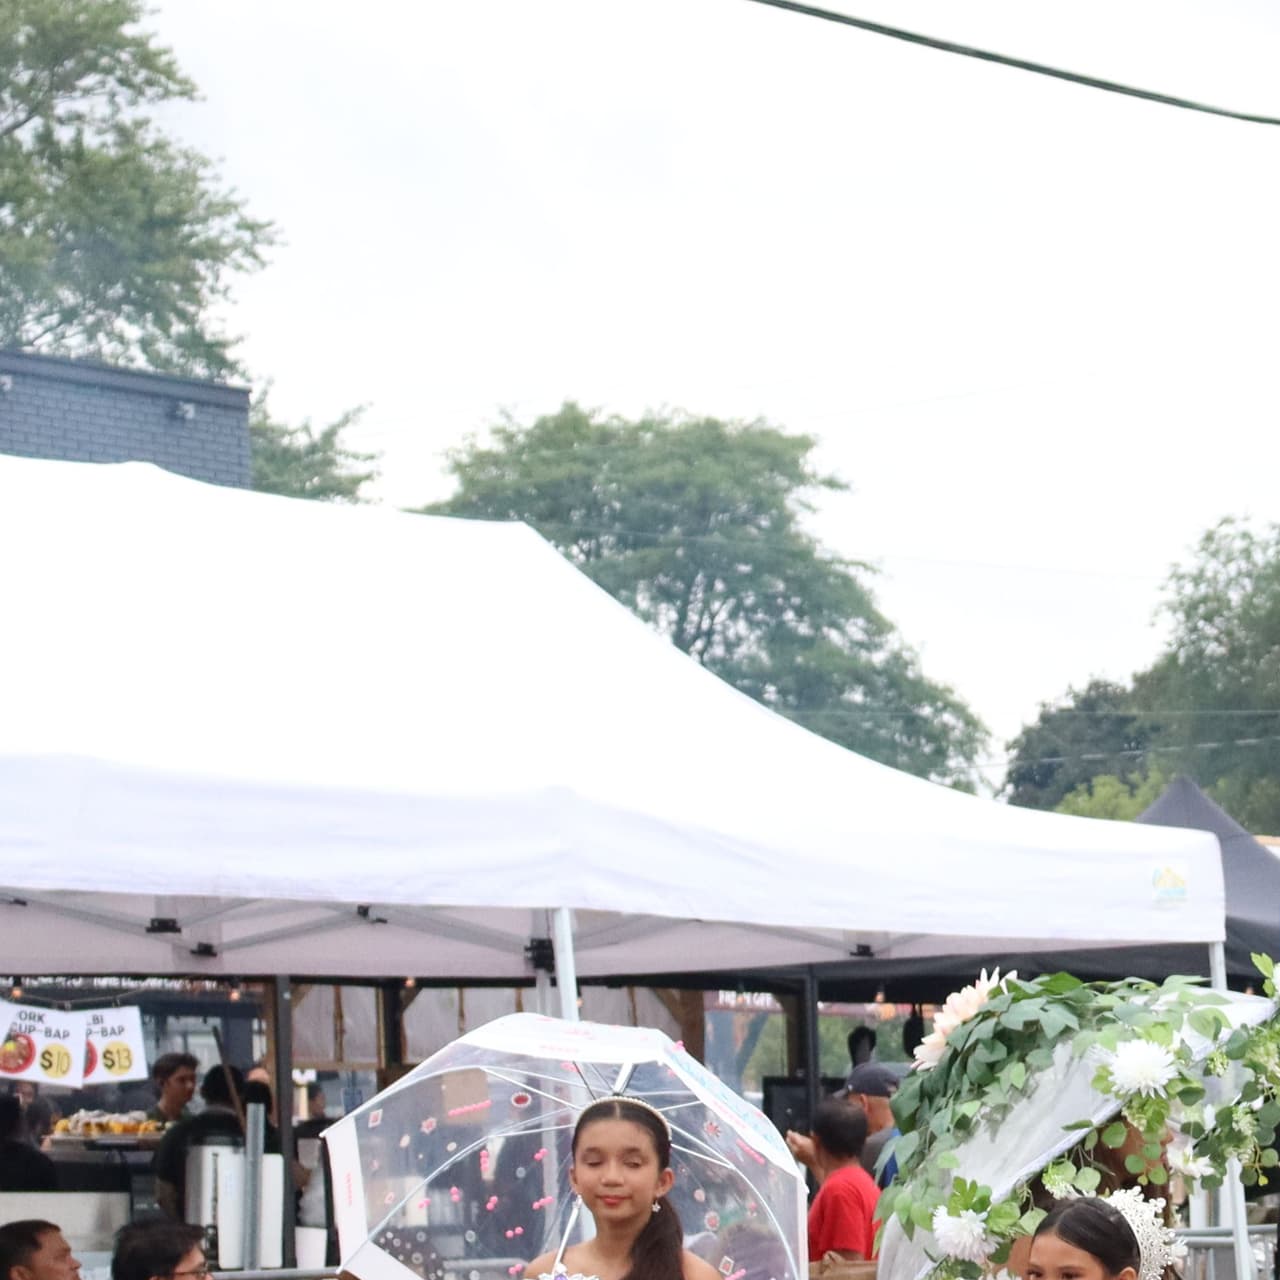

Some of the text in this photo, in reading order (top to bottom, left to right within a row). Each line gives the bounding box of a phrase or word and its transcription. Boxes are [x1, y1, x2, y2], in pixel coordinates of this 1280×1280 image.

[18, 1010, 46, 1024] ORK
[86, 1025, 125, 1038] P-BAP
[40, 1049, 72, 1075] $10
[102, 1048, 133, 1070] $13
